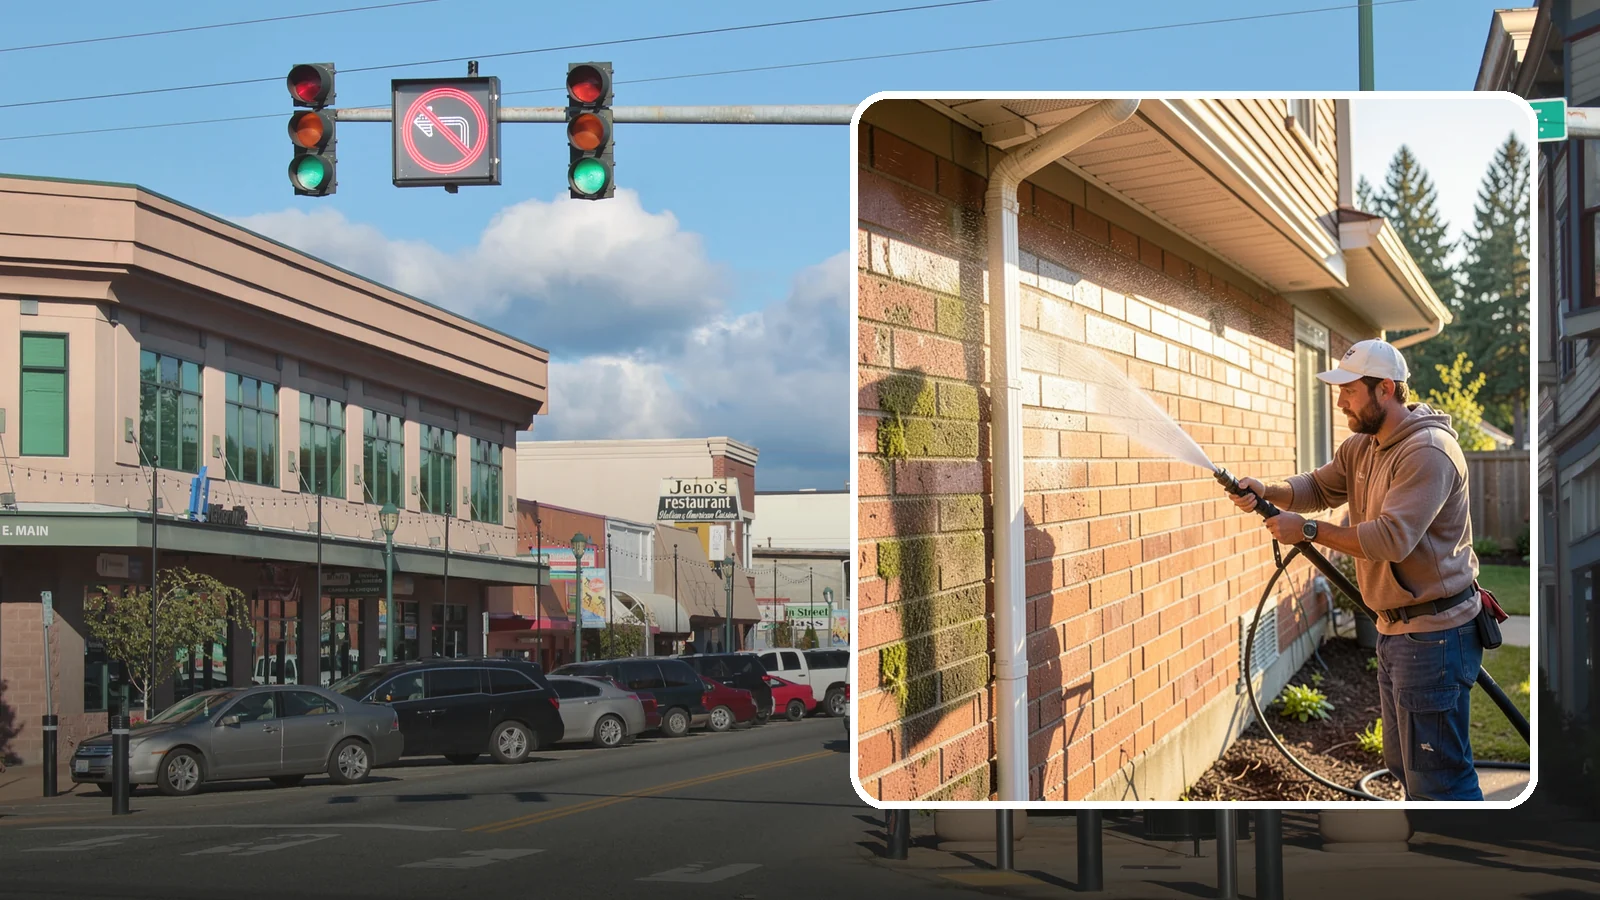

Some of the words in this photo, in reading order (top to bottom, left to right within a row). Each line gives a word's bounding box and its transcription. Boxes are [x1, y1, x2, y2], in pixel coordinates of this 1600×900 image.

[669, 479, 727, 495] Jeno's
[665, 496, 731, 509] restaurant
[658, 509, 681, 519] Italian
[686, 509, 715, 519] American
[715, 509, 738, 519] Cuisine
[2, 525, 13, 536] E.
[15, 525, 49, 536] MAIN
[797, 607, 829, 617] Street
[791, 619, 824, 627] lass
